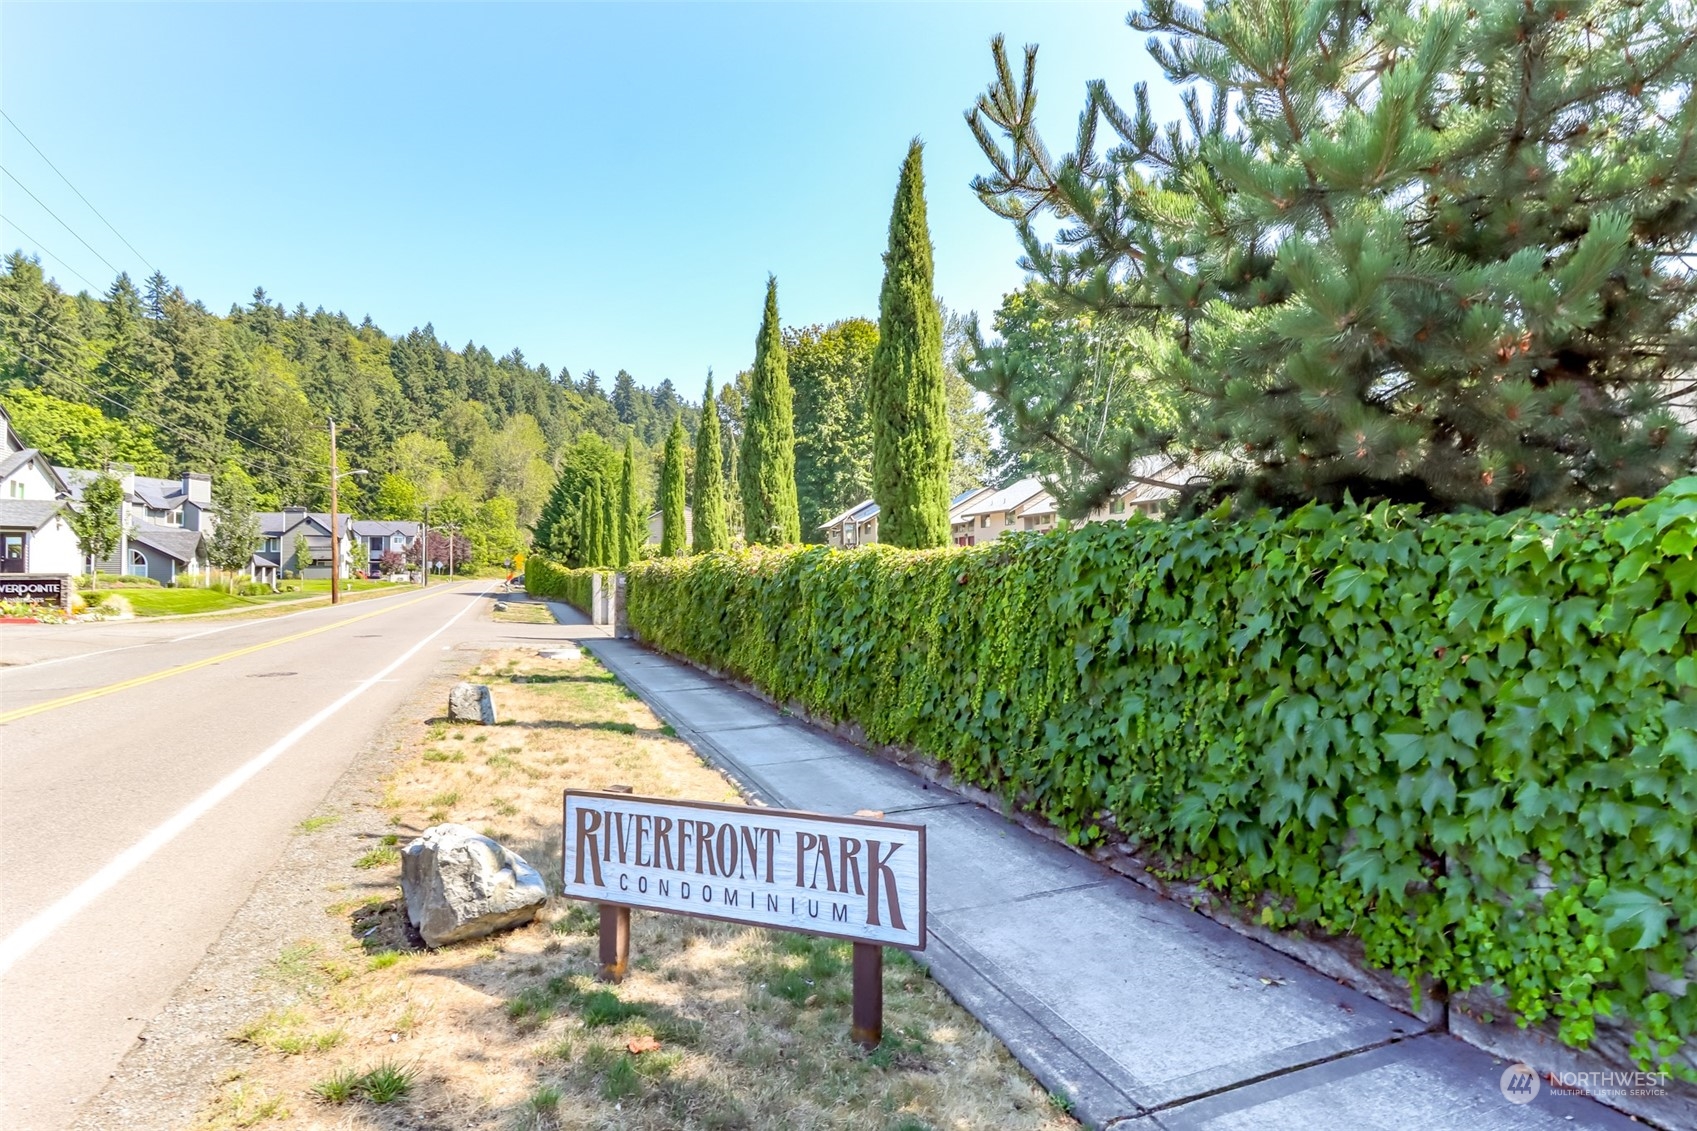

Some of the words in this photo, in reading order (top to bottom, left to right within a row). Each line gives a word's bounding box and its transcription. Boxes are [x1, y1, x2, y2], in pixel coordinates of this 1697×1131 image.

[574, 807, 781, 887] RIVERFRONT
[795, 831, 907, 930] PARK
[619, 873, 848, 922] CONDOMINIUM
